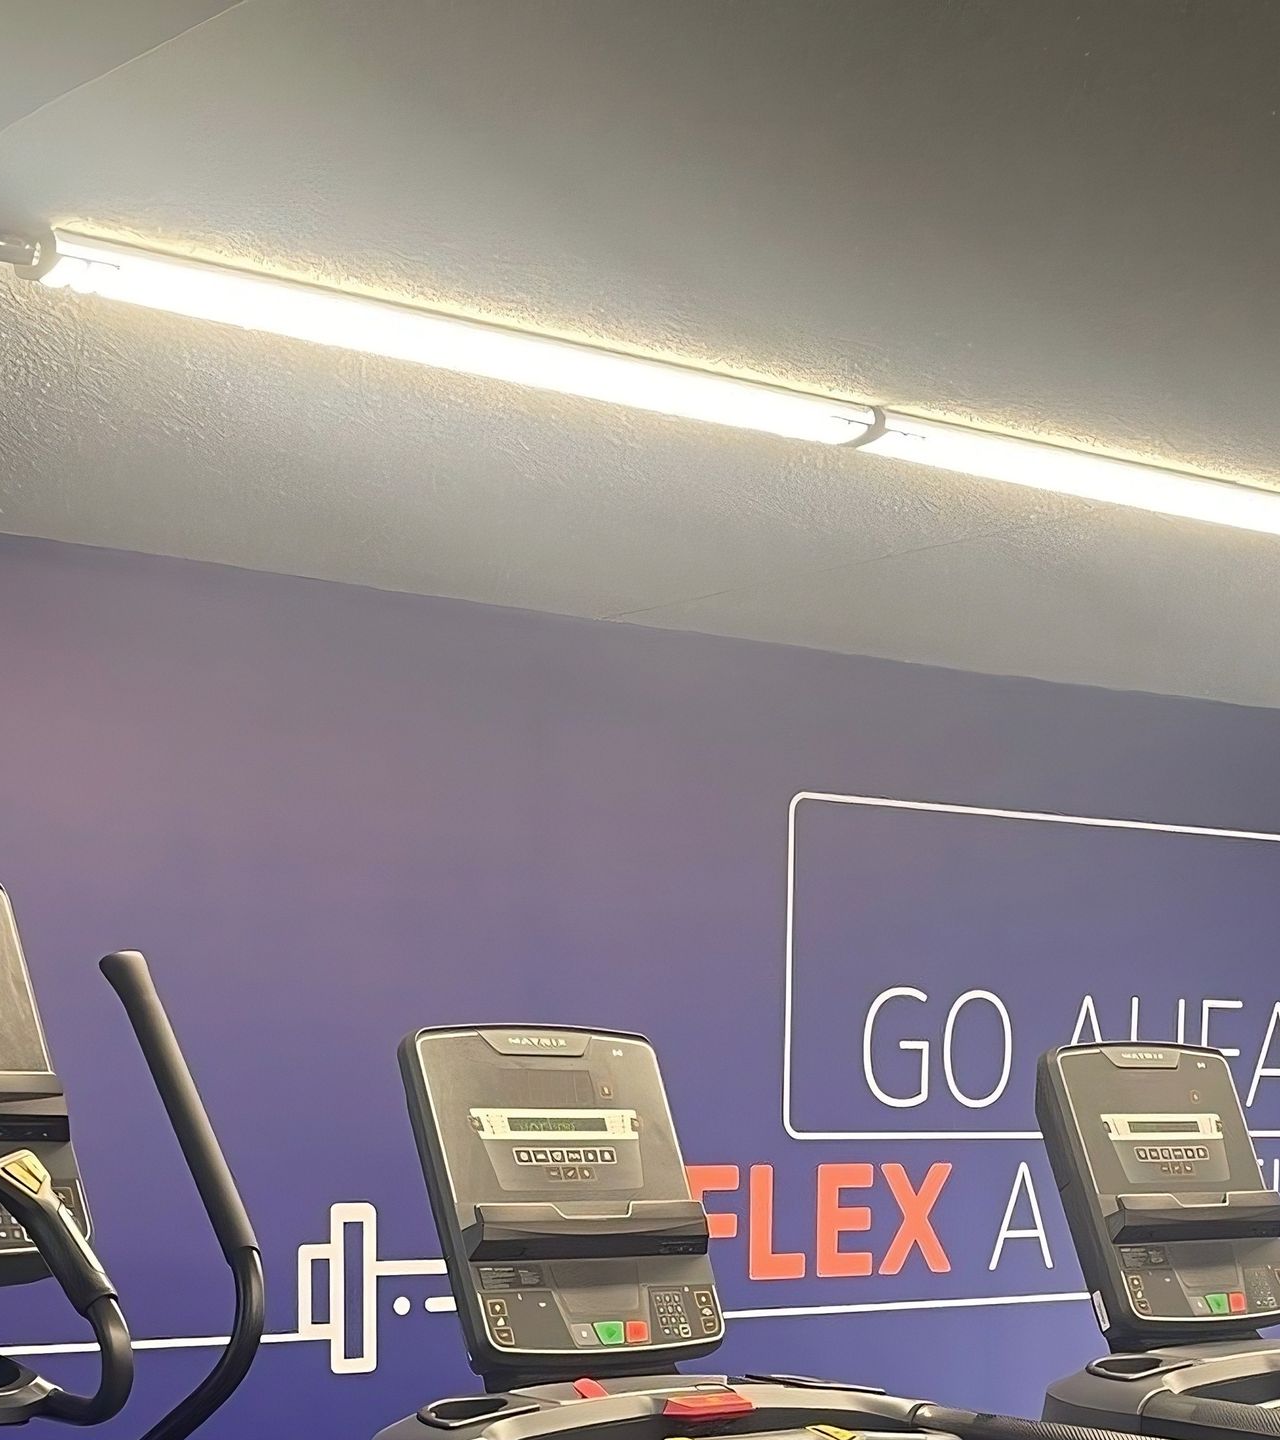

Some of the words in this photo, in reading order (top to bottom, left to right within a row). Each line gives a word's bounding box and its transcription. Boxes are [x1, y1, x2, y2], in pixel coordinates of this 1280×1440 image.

[863, 987, 1013, 1109] GO
[684, 1162, 952, 1280] FLEX
[989, 1161, 1053, 1271] A
